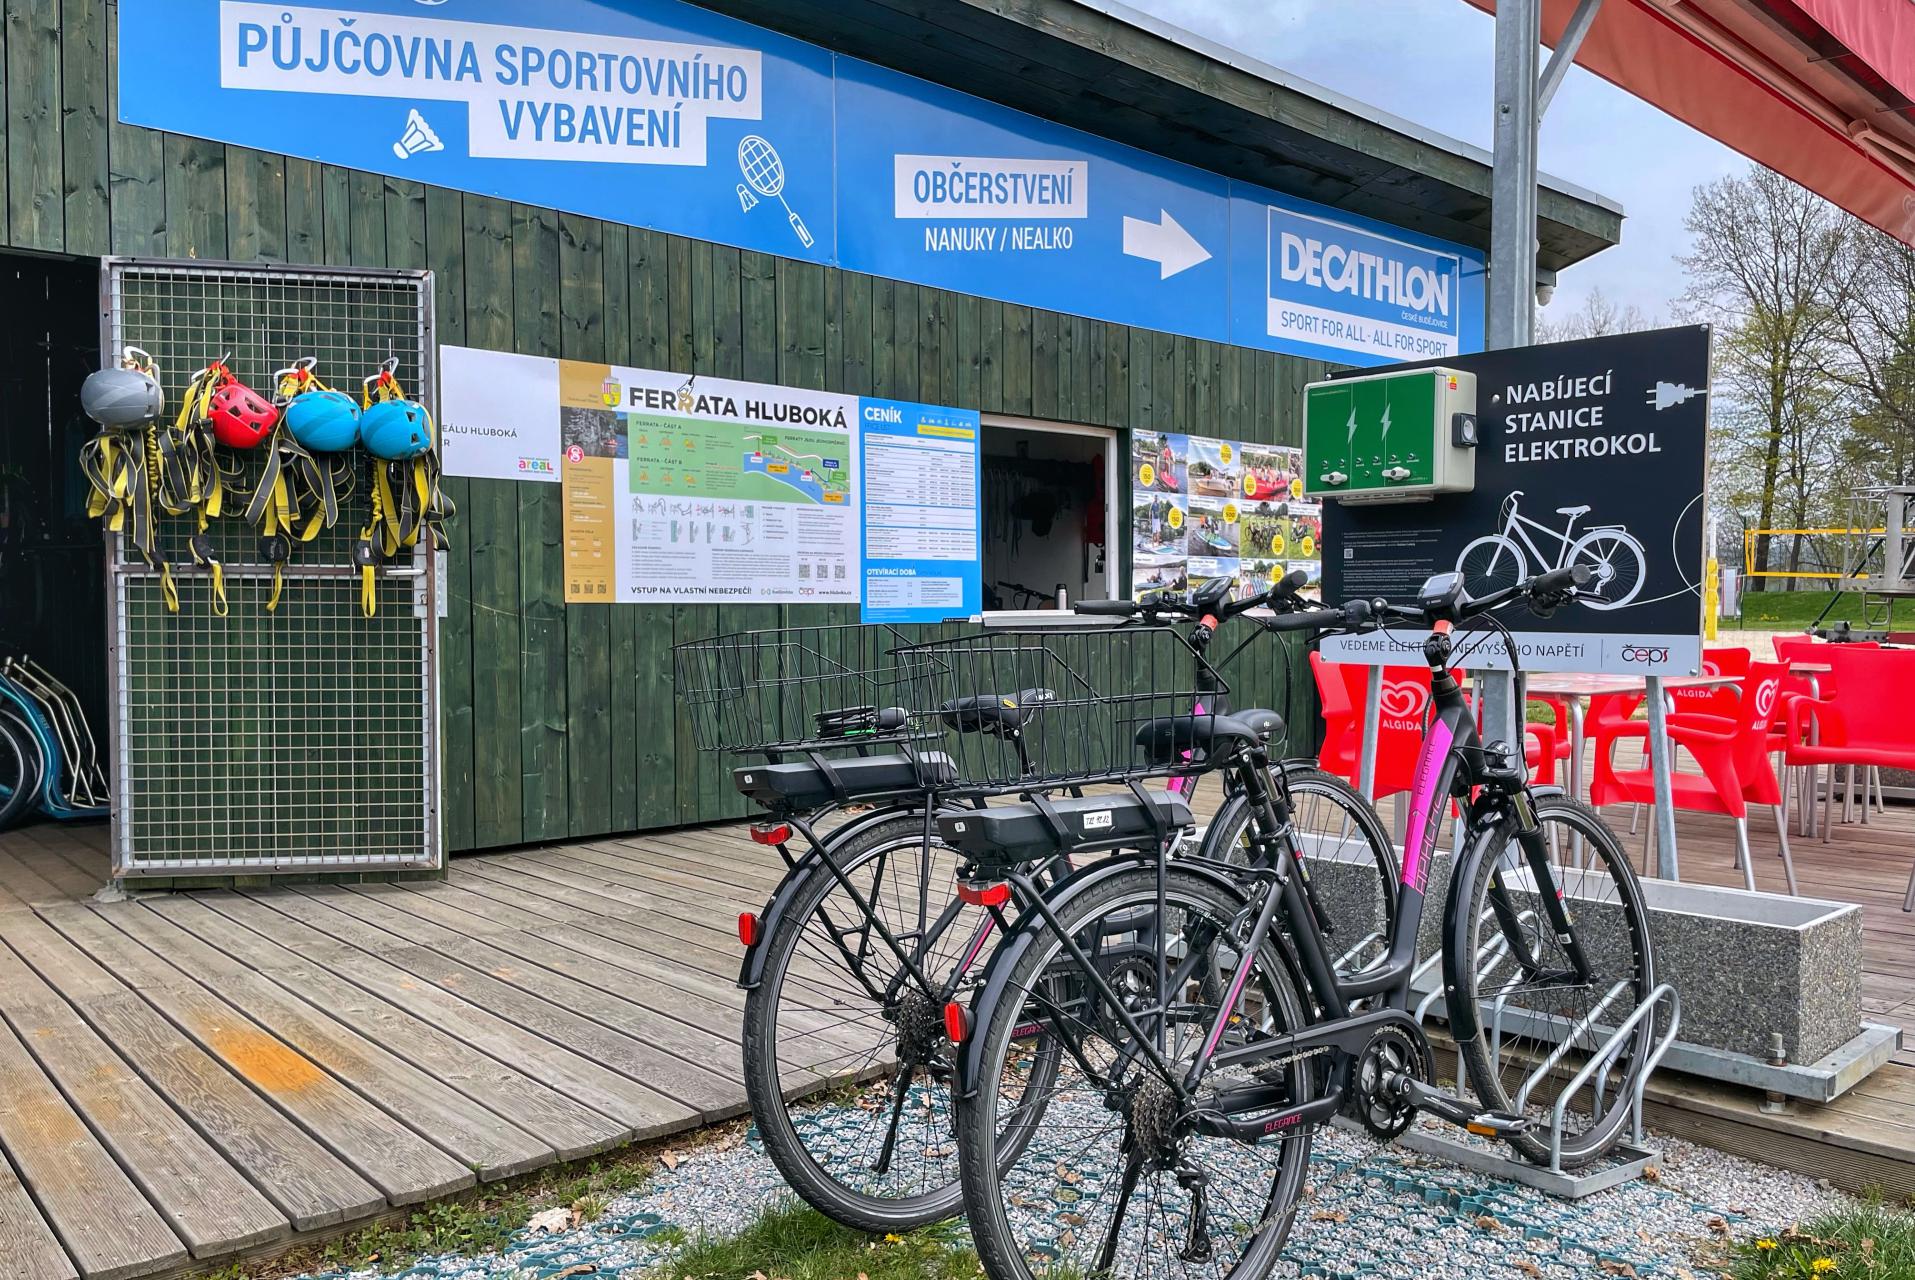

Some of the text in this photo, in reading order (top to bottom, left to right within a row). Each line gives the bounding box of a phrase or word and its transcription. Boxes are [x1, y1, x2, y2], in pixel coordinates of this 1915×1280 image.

[238, 12, 748, 103] PŮJČOVNA SPORTOVNÍHO
[498, 100, 683, 149] VYBAVENÍ
[913, 162, 1073, 205] OBČERSTVENÍ
[925, 226, 1073, 252] NANUKY / NEALKO
[1281, 231, 1449, 317] DECATHLON
[1401, 310, 1448, 329] ČESKÉ BUDĚJOVICE
[1281, 311, 1319, 333] SPORT
[1322, 318, 1343, 339] FOR
[1345, 324, 1366, 342] ALL
[1373, 329, 1393, 348] ALL
[1395, 333, 1415, 353] FOR
[1416, 338, 1448, 357] SPORT
[1506, 369, 1612, 404] NABÍJECÍ
[629, 386, 847, 428] FERRATA HLUBOKÁ
[864, 406, 902, 424] CENÍK
[441, 423, 518, 438] EÁLU HLUBOKÁ
[1505, 406, 1603, 434] STANICE
[442, 439, 451, 447] R
[1505, 432, 1661, 463] ELEKTROKOL
[900, 568, 916, 576] DOBA
[631, 586, 752, 595] VSTUP NA VLASTNÍ NEBEZPEČÍ!
[1340, 639, 1386, 651] VEDEME
[1536, 643, 1585, 658] NAPĚTÍ
[1677, 688, 1713, 699] ALGIDA
[1382, 719, 1422, 731] ALGIDA
[1264, 1113, 1303, 1133] ELEGANCE
